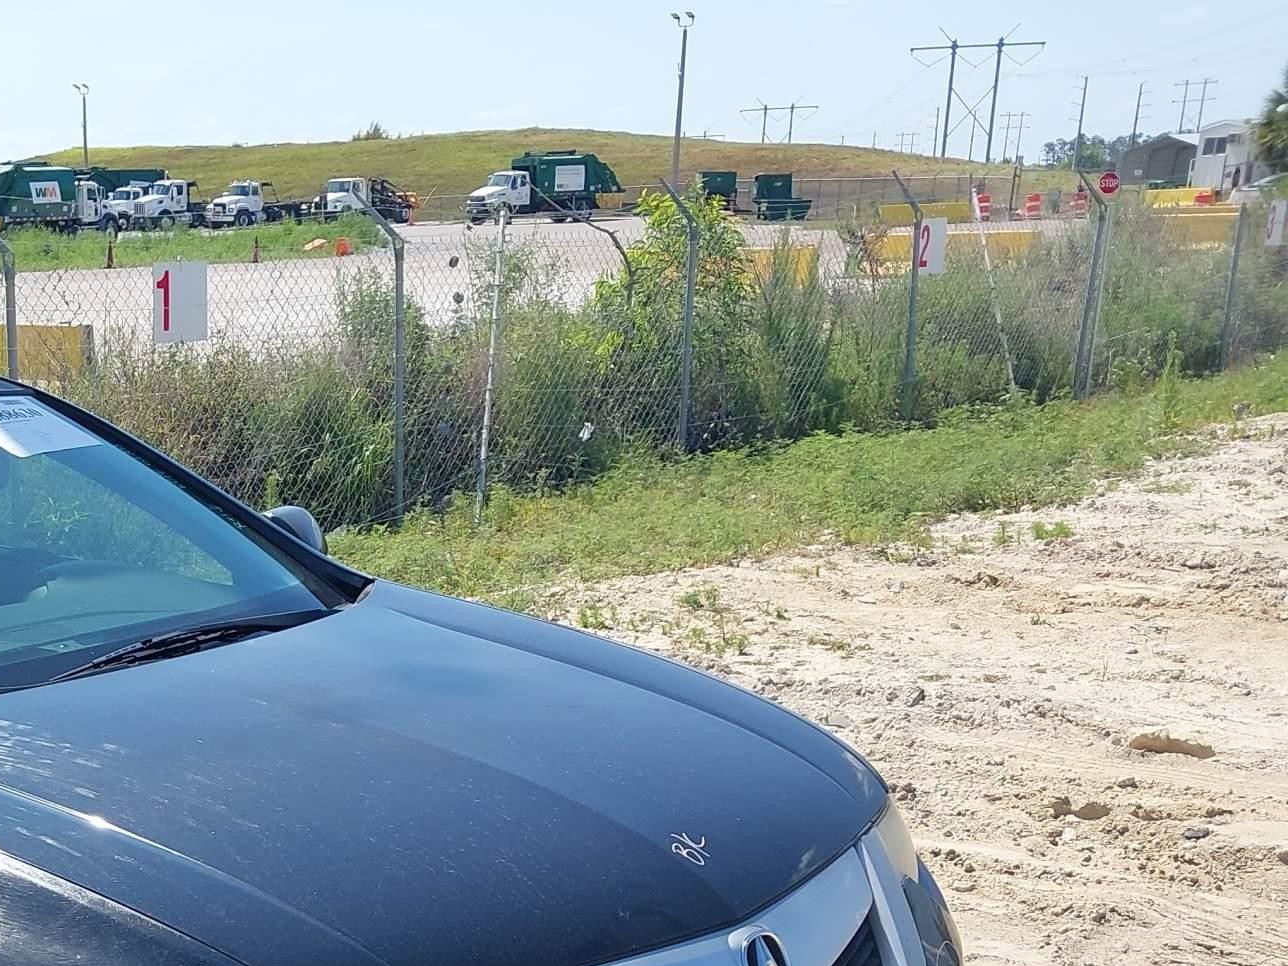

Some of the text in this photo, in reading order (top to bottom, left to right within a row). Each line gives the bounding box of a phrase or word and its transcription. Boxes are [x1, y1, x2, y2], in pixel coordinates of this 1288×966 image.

[35, 187, 57, 198] WM
[1100, 179, 1119, 188] STOP
[918, 224, 931, 268] 2
[156, 269, 170, 332] 1
